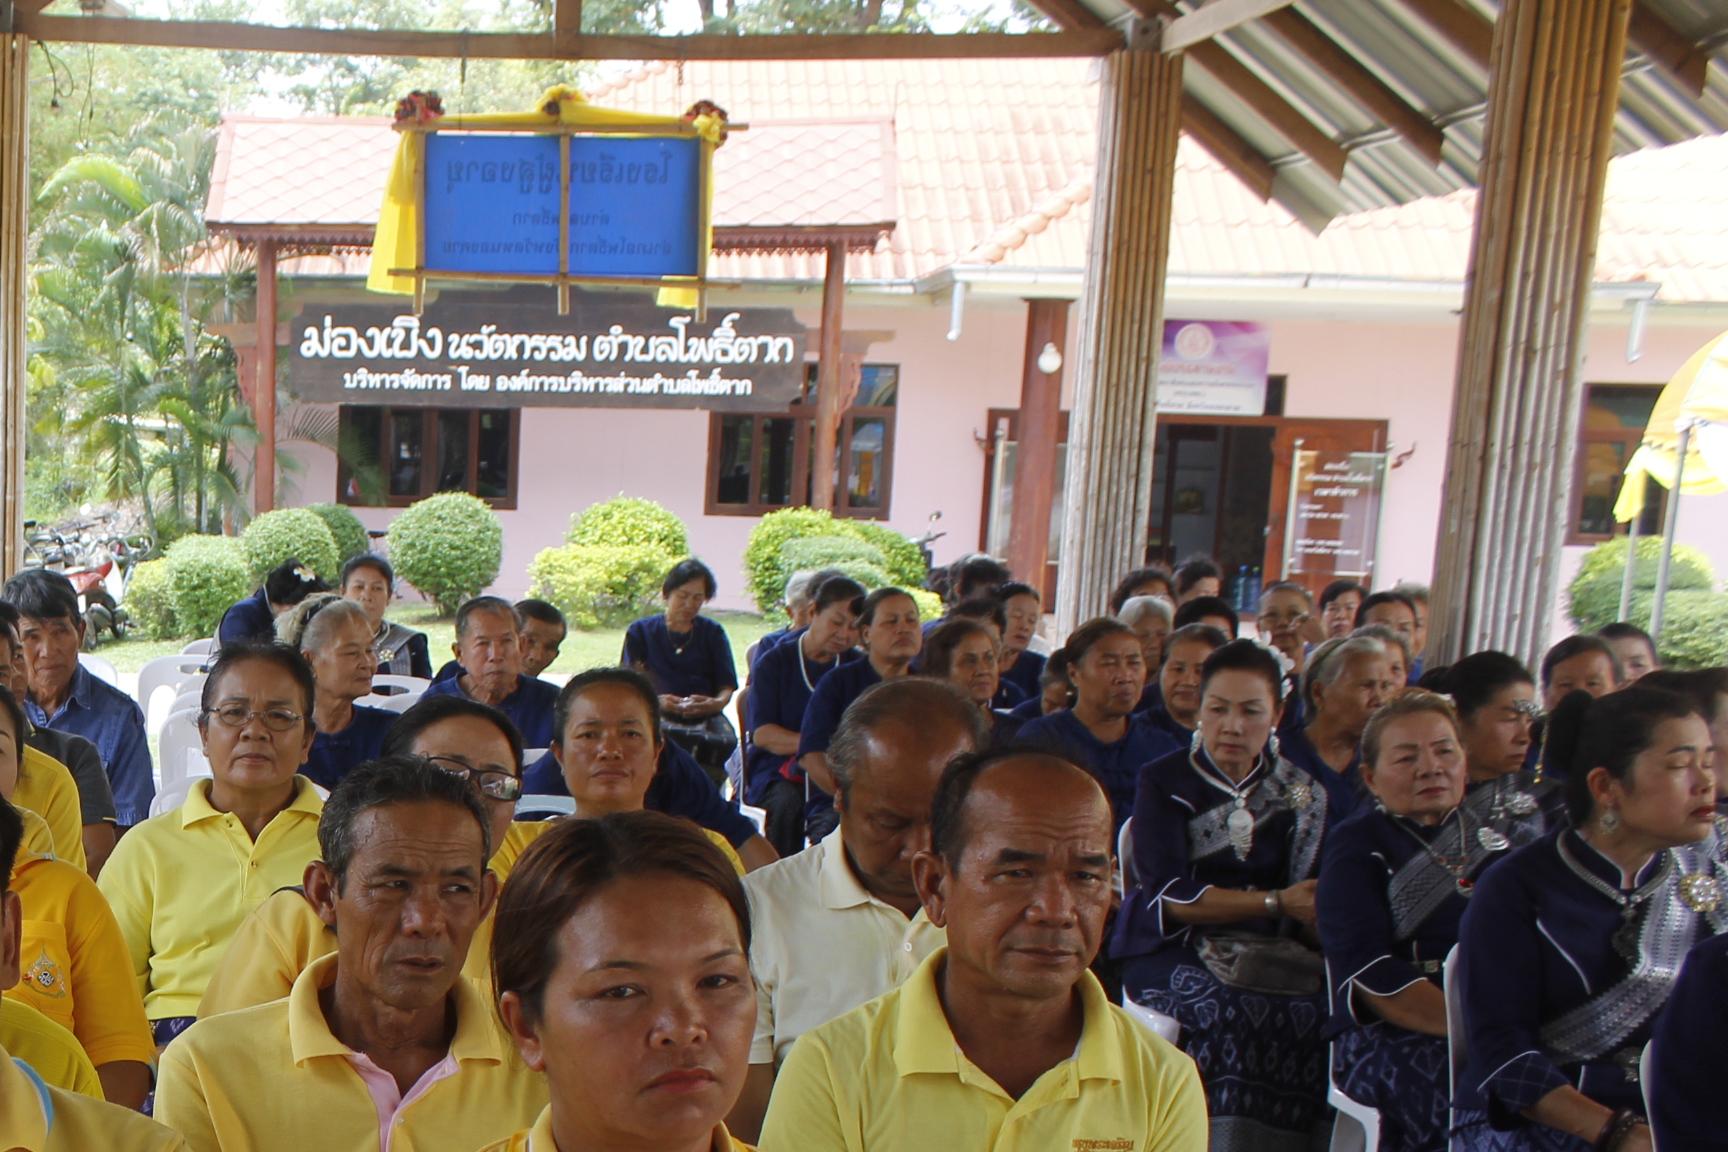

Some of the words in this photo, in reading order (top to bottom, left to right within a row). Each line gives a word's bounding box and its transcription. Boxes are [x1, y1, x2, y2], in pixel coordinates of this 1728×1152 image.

[447, 324, 588, 362] นวัตกรรม
[592, 312, 794, 364] ตำบลโพธิ์ตาก
[343, 366, 452, 390] บริหารจัดการ
[457, 365, 491, 391] โดย
